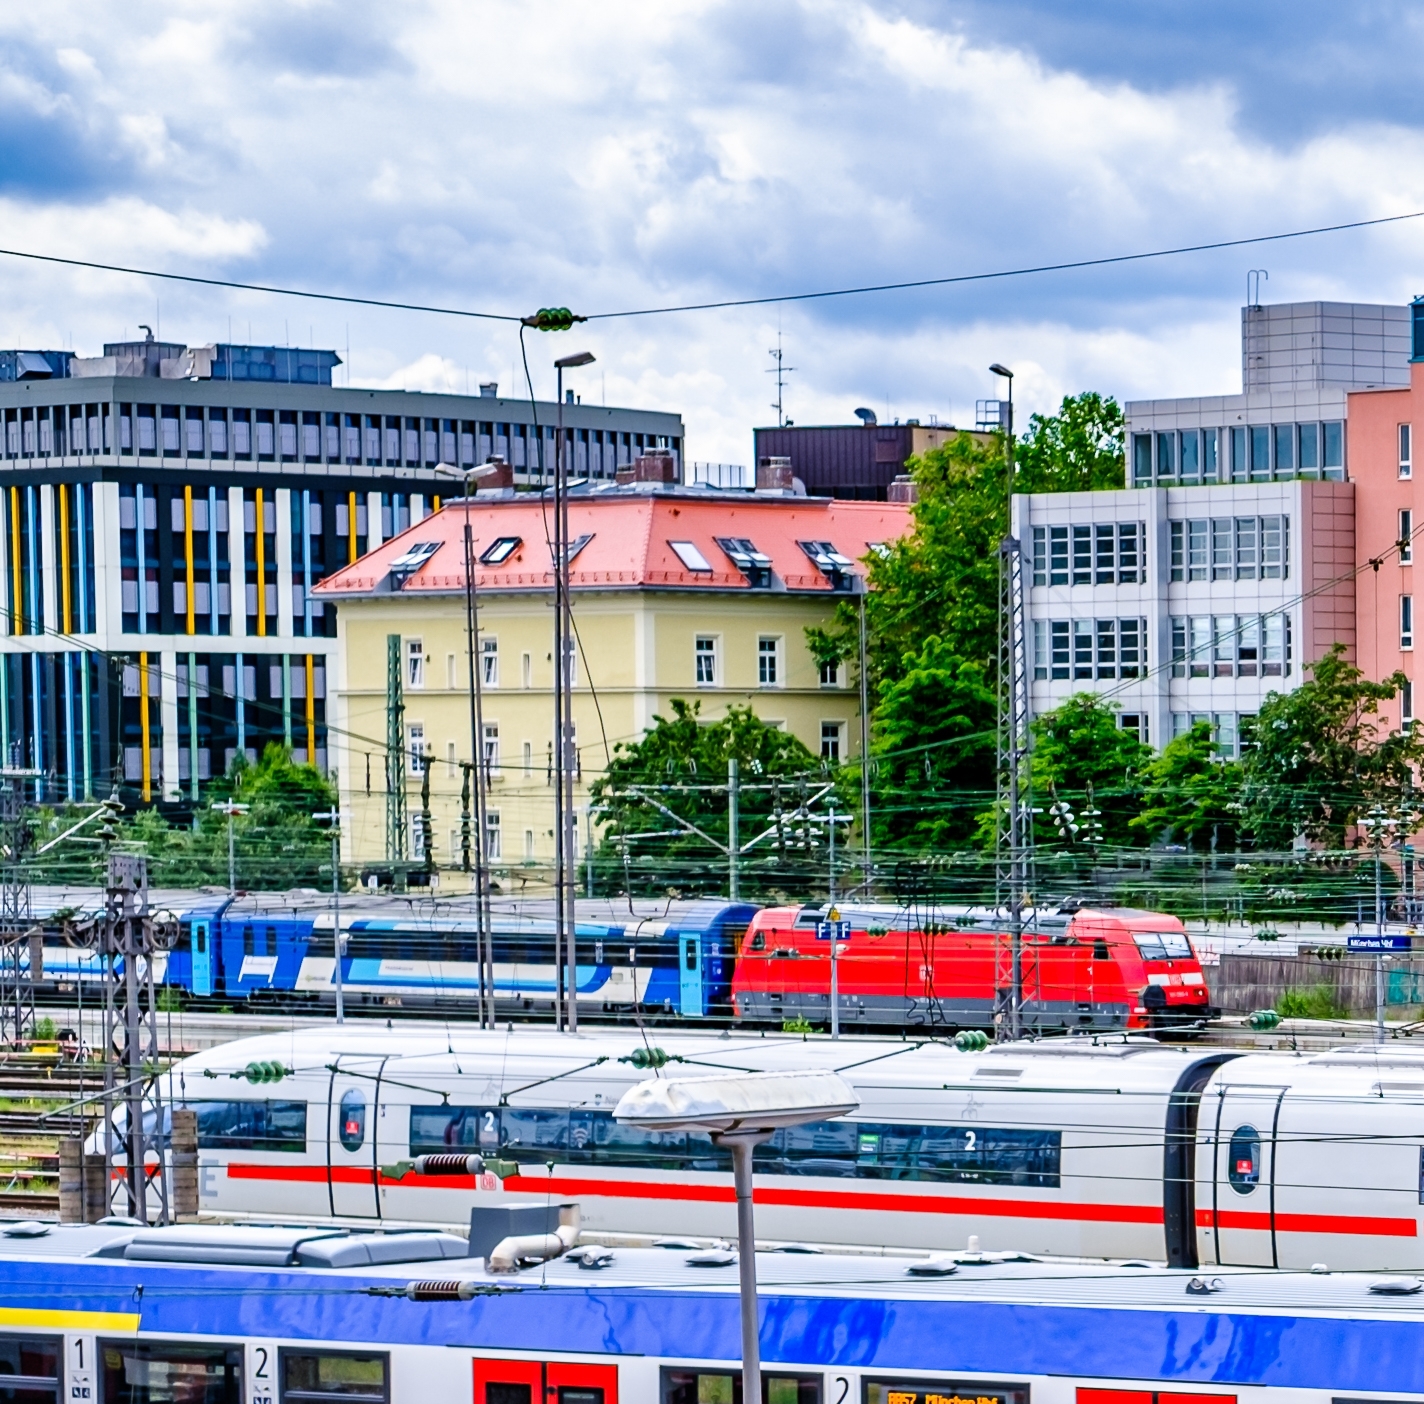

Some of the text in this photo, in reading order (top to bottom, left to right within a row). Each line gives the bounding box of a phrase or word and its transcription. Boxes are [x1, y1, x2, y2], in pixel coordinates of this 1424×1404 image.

[818, 922, 849, 938] F F
[483, 1112, 496, 1132] 2
[964, 1131, 976, 1151] 2
[483, 1175, 494, 1189] DB
[75, 1338, 83, 1369] 1
[255, 1347, 268, 1378] 2
